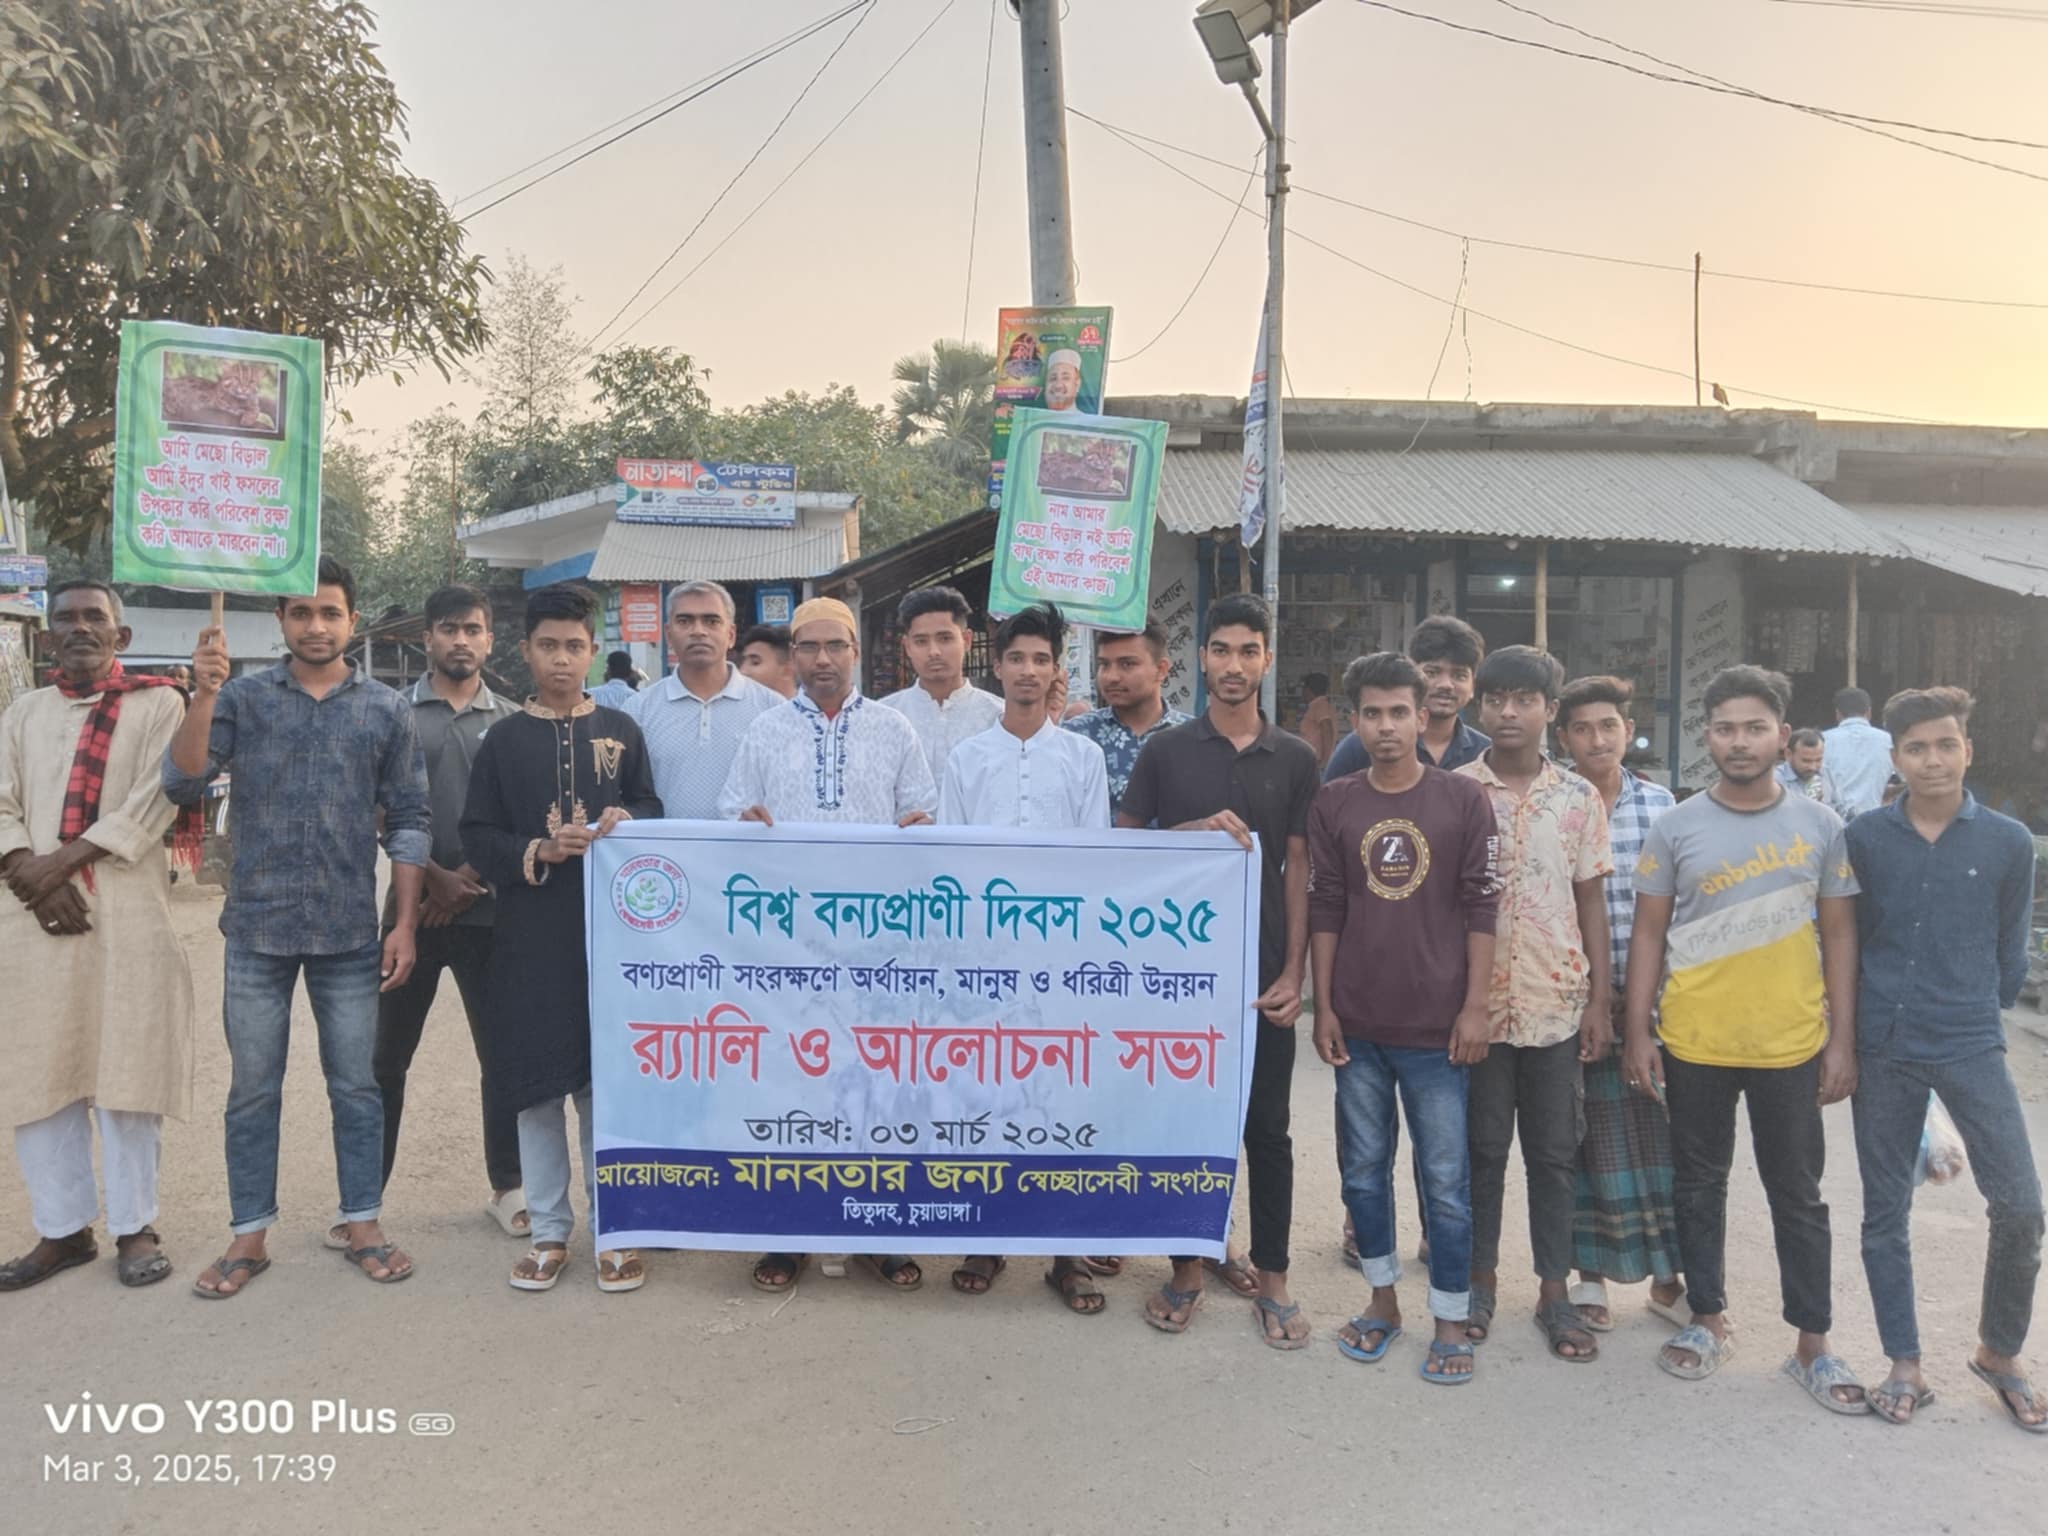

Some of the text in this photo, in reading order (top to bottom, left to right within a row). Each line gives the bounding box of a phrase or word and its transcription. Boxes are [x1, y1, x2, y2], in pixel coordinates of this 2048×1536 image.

[161, 435, 268, 468] আমি মেছো বিড়াল
[146, 464, 174, 488] আমি
[624, 462, 792, 482] নাতাশা টেলিকম
[141, 492, 289, 527] উপকার করি পরিবেশ রক্ষা
[1048, 502, 1107, 520] নাম আমার
[141, 521, 164, 544] করি
[169, 528, 214, 549] আমাকে
[1018, 522, 1133, 546] মেছো বিড়াল নই আমি
[1014, 544, 1131, 571] বাঘ রক্ষা করি পরিবেশ
[1023, 565, 1042, 583] এই
[1045, 571, 1079, 589] আমার
[1152, 577, 1187, 611] এখানে
[722, 873, 1218, 949] বিশ্ব বন্যপ্রাণী দিবস ২০২৫
[620, 954, 1218, 1003] বণ্যপ্রাণী সংরক্ষণে অর্থায়ন, মানুষ ও ধরিত্রী উন্নয়ন
[788, 1027, 830, 1077] ও
[850, 1019, 1100, 1089] আলোচনা
[1112, 1023, 1226, 1089] সভা
[743, 1109, 1100, 1150] তারিখ: ০৩ মার্চ ২০২৫
[595, 1154, 1233, 1198] আয়োজনে: মানবতার জন্য স্বেচ্ছাসেবী সংগঠন
[841, 1196, 903, 1227] তিতুদহ,
